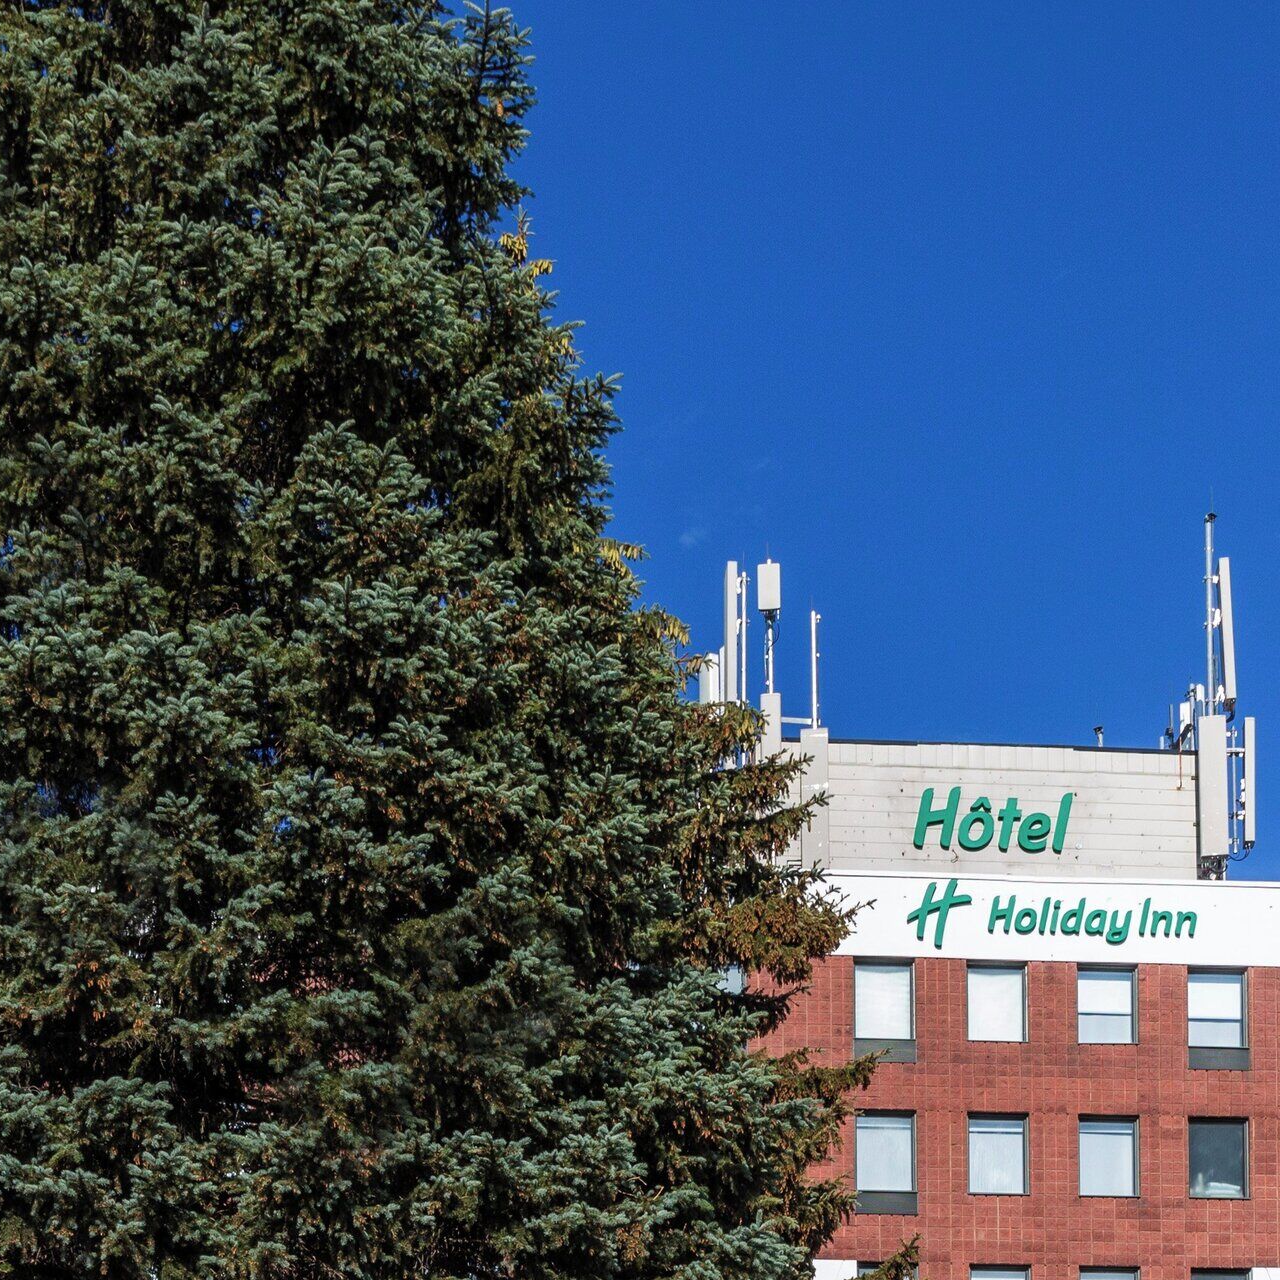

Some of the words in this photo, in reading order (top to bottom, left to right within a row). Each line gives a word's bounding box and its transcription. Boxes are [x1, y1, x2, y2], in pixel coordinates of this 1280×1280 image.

[913, 786, 1074, 854] Hôtel
[988, 895, 1133, 944] Holiday
[1138, 898, 1198, 938] Inn
